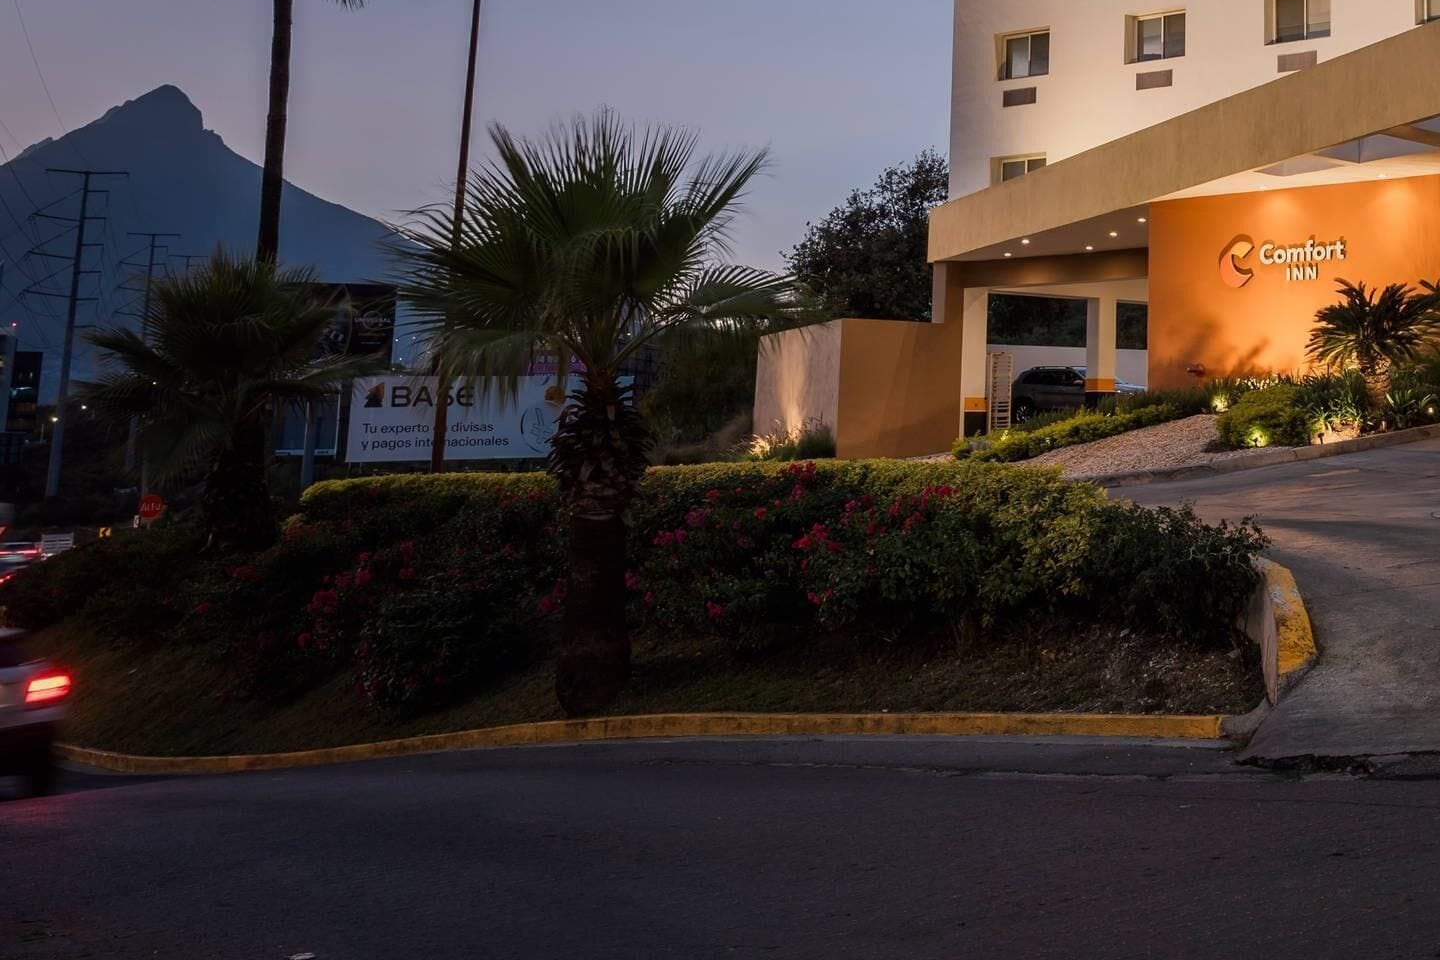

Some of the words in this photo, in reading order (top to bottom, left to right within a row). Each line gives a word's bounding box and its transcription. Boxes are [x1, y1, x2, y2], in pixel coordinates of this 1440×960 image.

[1259, 240, 1344, 264] Comfort
[1286, 267, 1317, 280] INN
[362, 423, 377, 433] Tu
[381, 423, 429, 436] experto
[451, 422, 494, 433] divisas
[361, 441, 369, 451] y
[372, 441, 411, 451] pagos
[415, 436, 509, 448] intacionales
